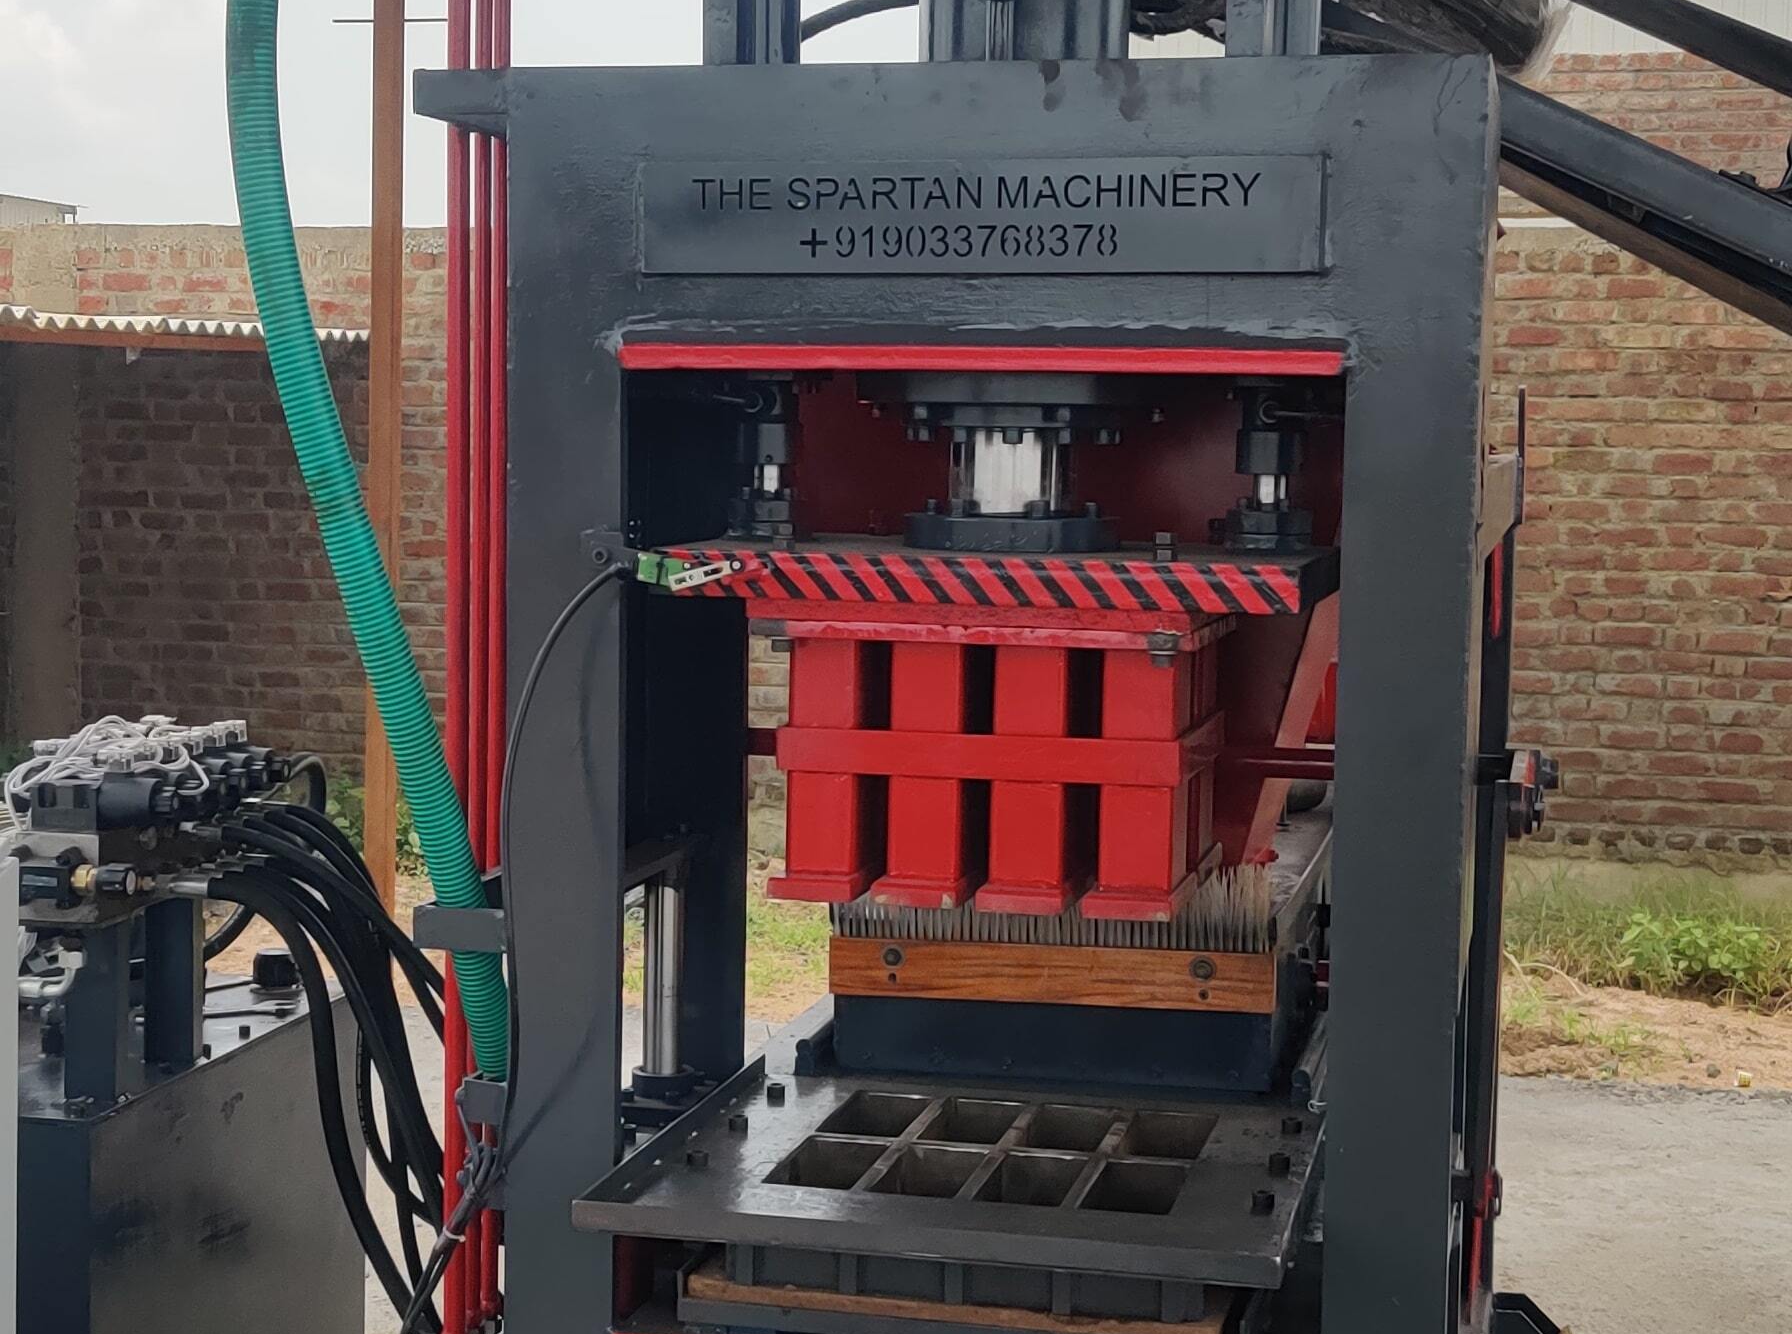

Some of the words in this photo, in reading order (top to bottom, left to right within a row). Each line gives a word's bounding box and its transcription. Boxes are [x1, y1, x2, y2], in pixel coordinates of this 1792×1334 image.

[692, 177, 772, 211] THE
[786, 175, 984, 211] SPARTAN
[996, 172, 1262, 210] MACHINERY
[799, 223, 1118, 259] +919033768378
